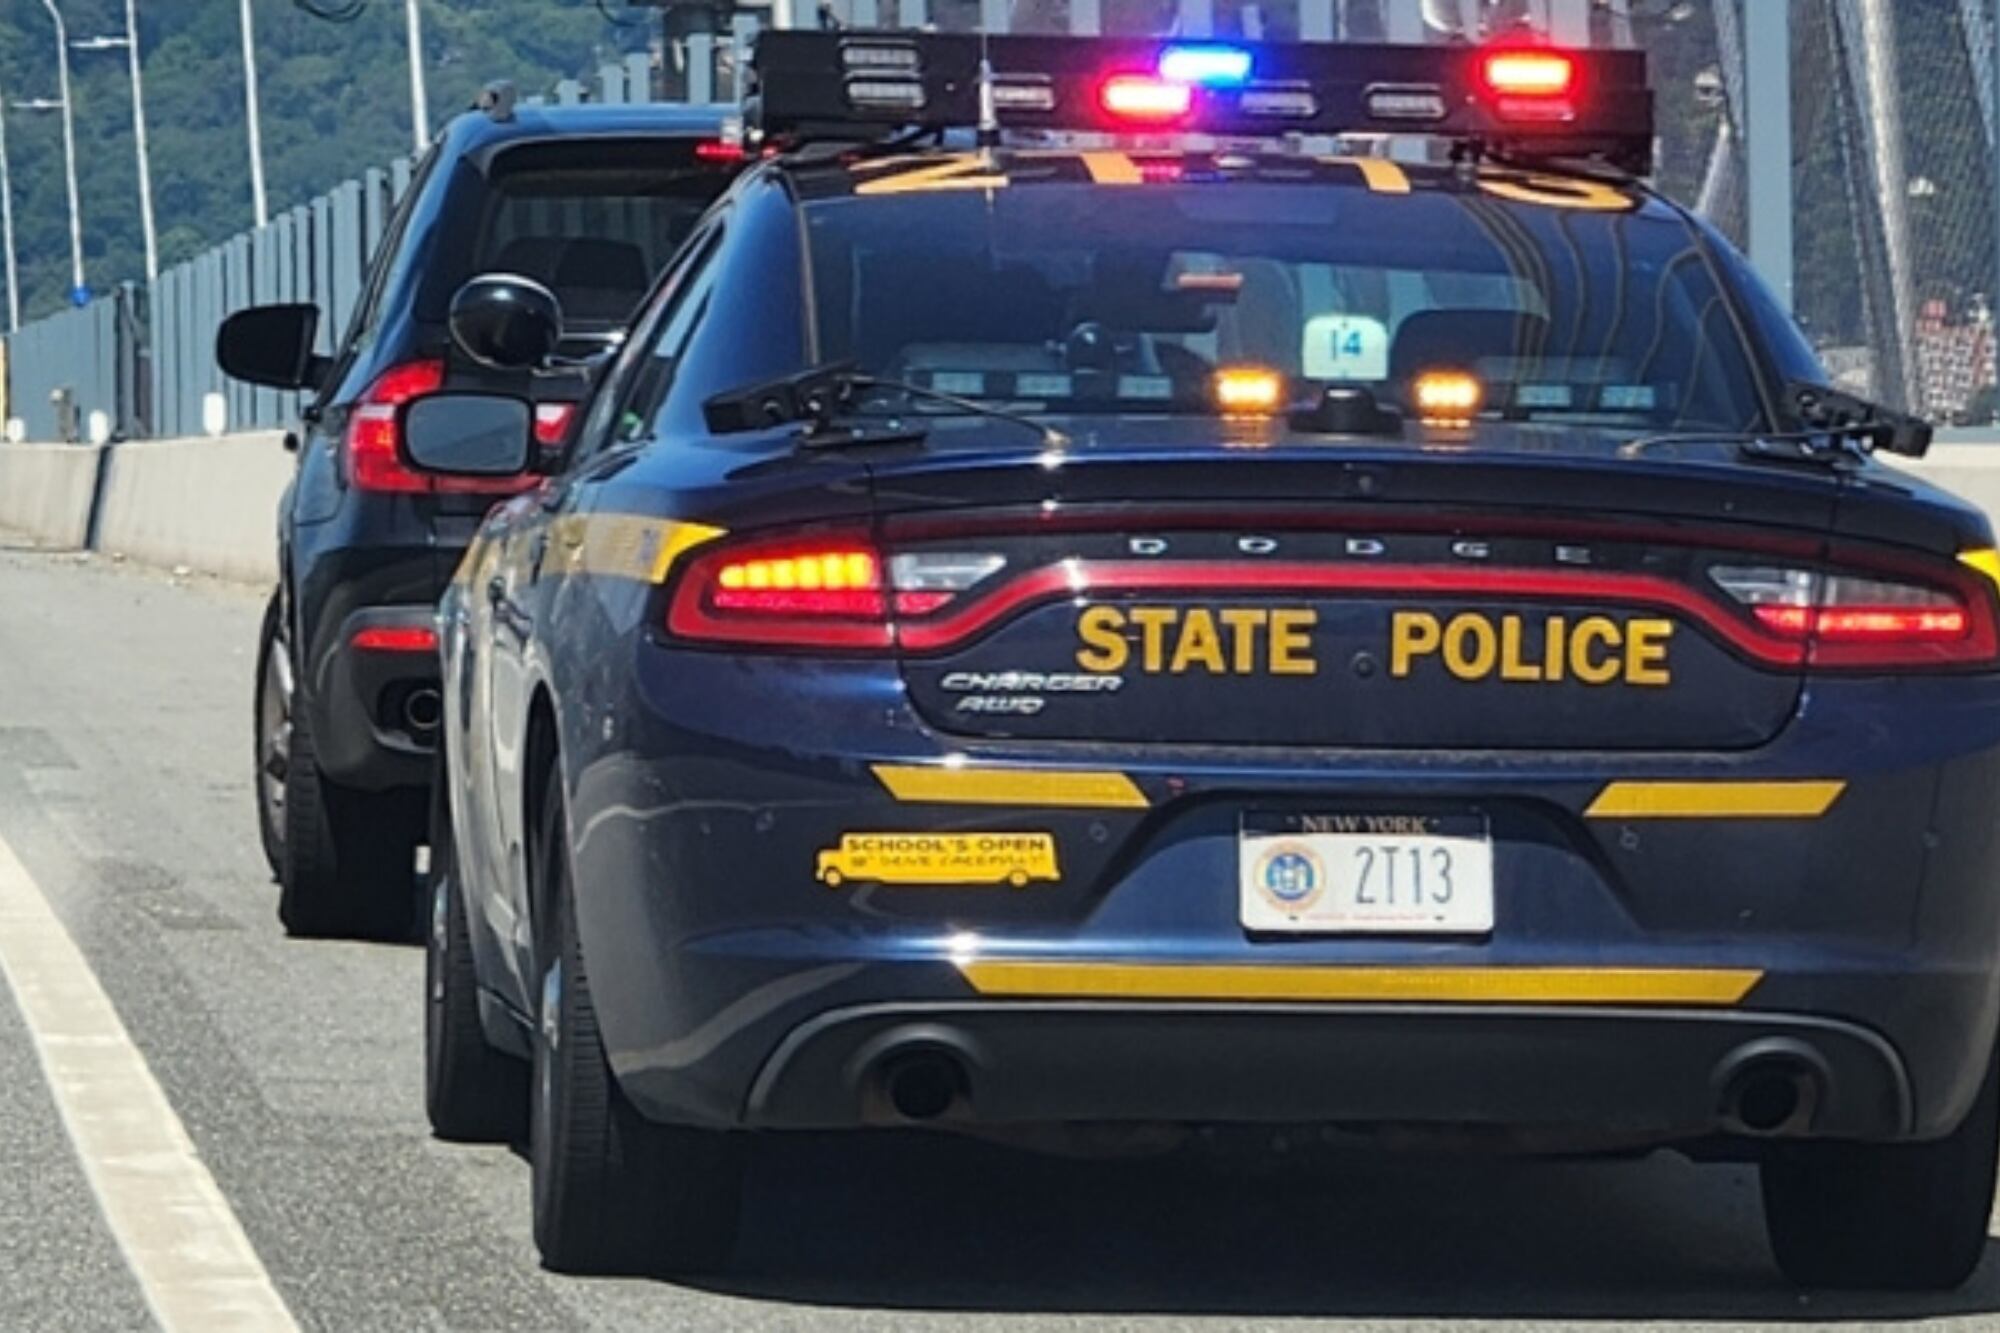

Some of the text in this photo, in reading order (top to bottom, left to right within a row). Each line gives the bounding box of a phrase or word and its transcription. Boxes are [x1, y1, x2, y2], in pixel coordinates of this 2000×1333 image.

[1129, 537, 1591, 563] DODGE
[1077, 606, 1671, 685] STATE POLICE
[941, 671, 1123, 691] CHARGER
[956, 696, 1044, 713] AWD
[1302, 815, 1427, 834] NEW YORK
[847, 838, 1044, 852] SCHOOL'S OPEN
[1355, 846, 1453, 904] 2T13
